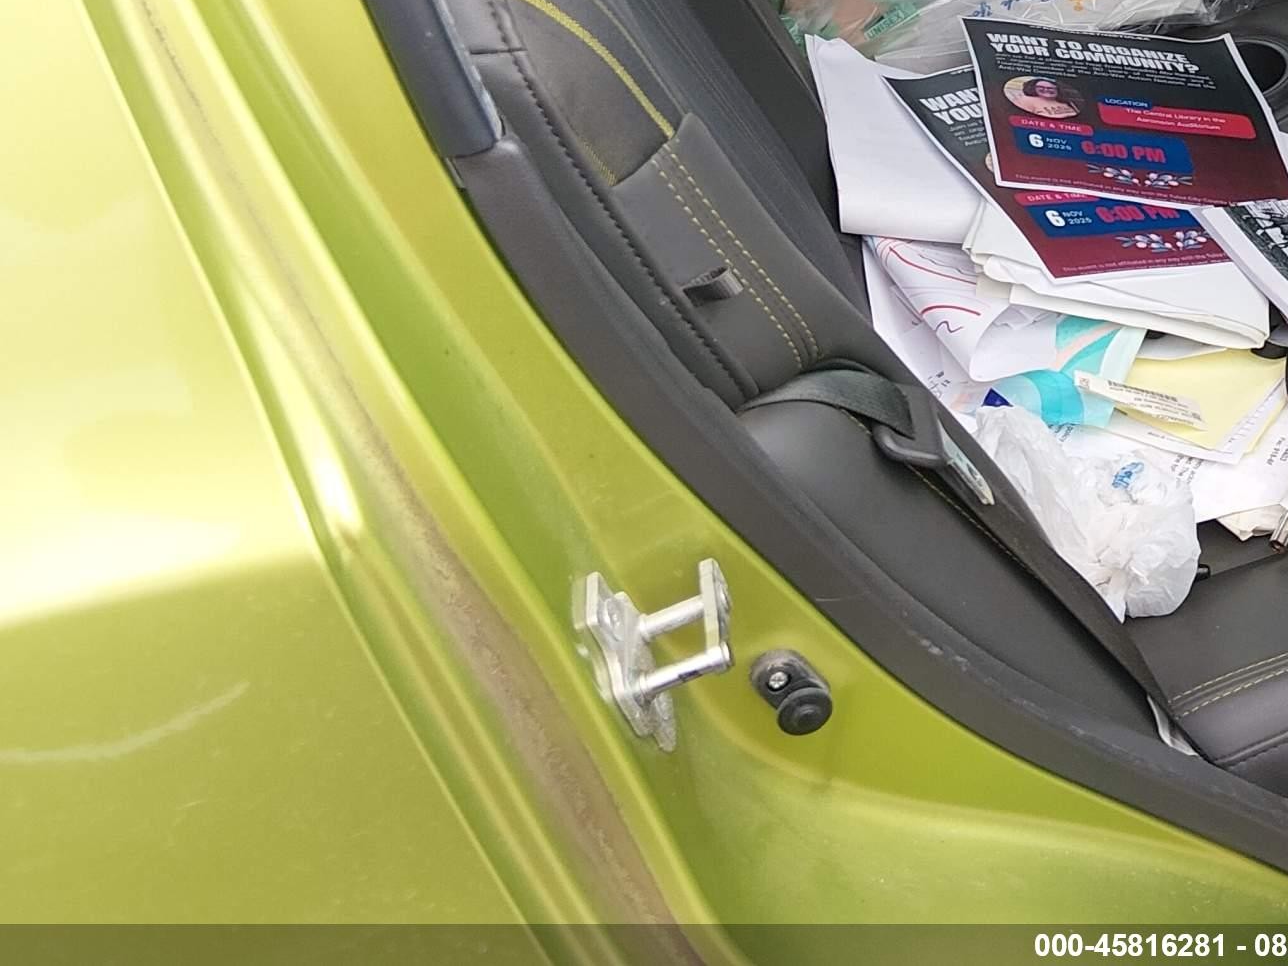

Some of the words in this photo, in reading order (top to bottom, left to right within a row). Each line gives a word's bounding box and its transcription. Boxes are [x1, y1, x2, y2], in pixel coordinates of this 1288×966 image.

[985, 33, 1050, 48] WANT
[1054, 39, 1085, 52] TO
[1087, 41, 1191, 65] ORGANIZE
[988, 42, 1051, 58] YOUR
[1055, 45, 1200, 74] COMMUNITY?
[1105, 98, 1149, 108] LOCATION
[1125, 107, 1143, 115] The
[1143, 109, 1173, 119] Central
[1175, 112, 1201, 123] Library
[1021, 118, 1047, 127] DATE
[1059, 124, 1082, 132] TIME
[1028, 133, 1044, 149] 6
[1046, 137, 1068, 145] NOV
[1047, 142, 1073, 152] 2025
[1080, 140, 1128, 159] 6:00
[1132, 145, 1167, 164] PM
[1027, 192, 1053, 202] DATE
[1045, 209, 1065, 228] 6
[1062, 210, 1083, 218] NOV
[1067, 217, 1092, 226] 2025
[1096, 205, 1144, 224] 6:00
